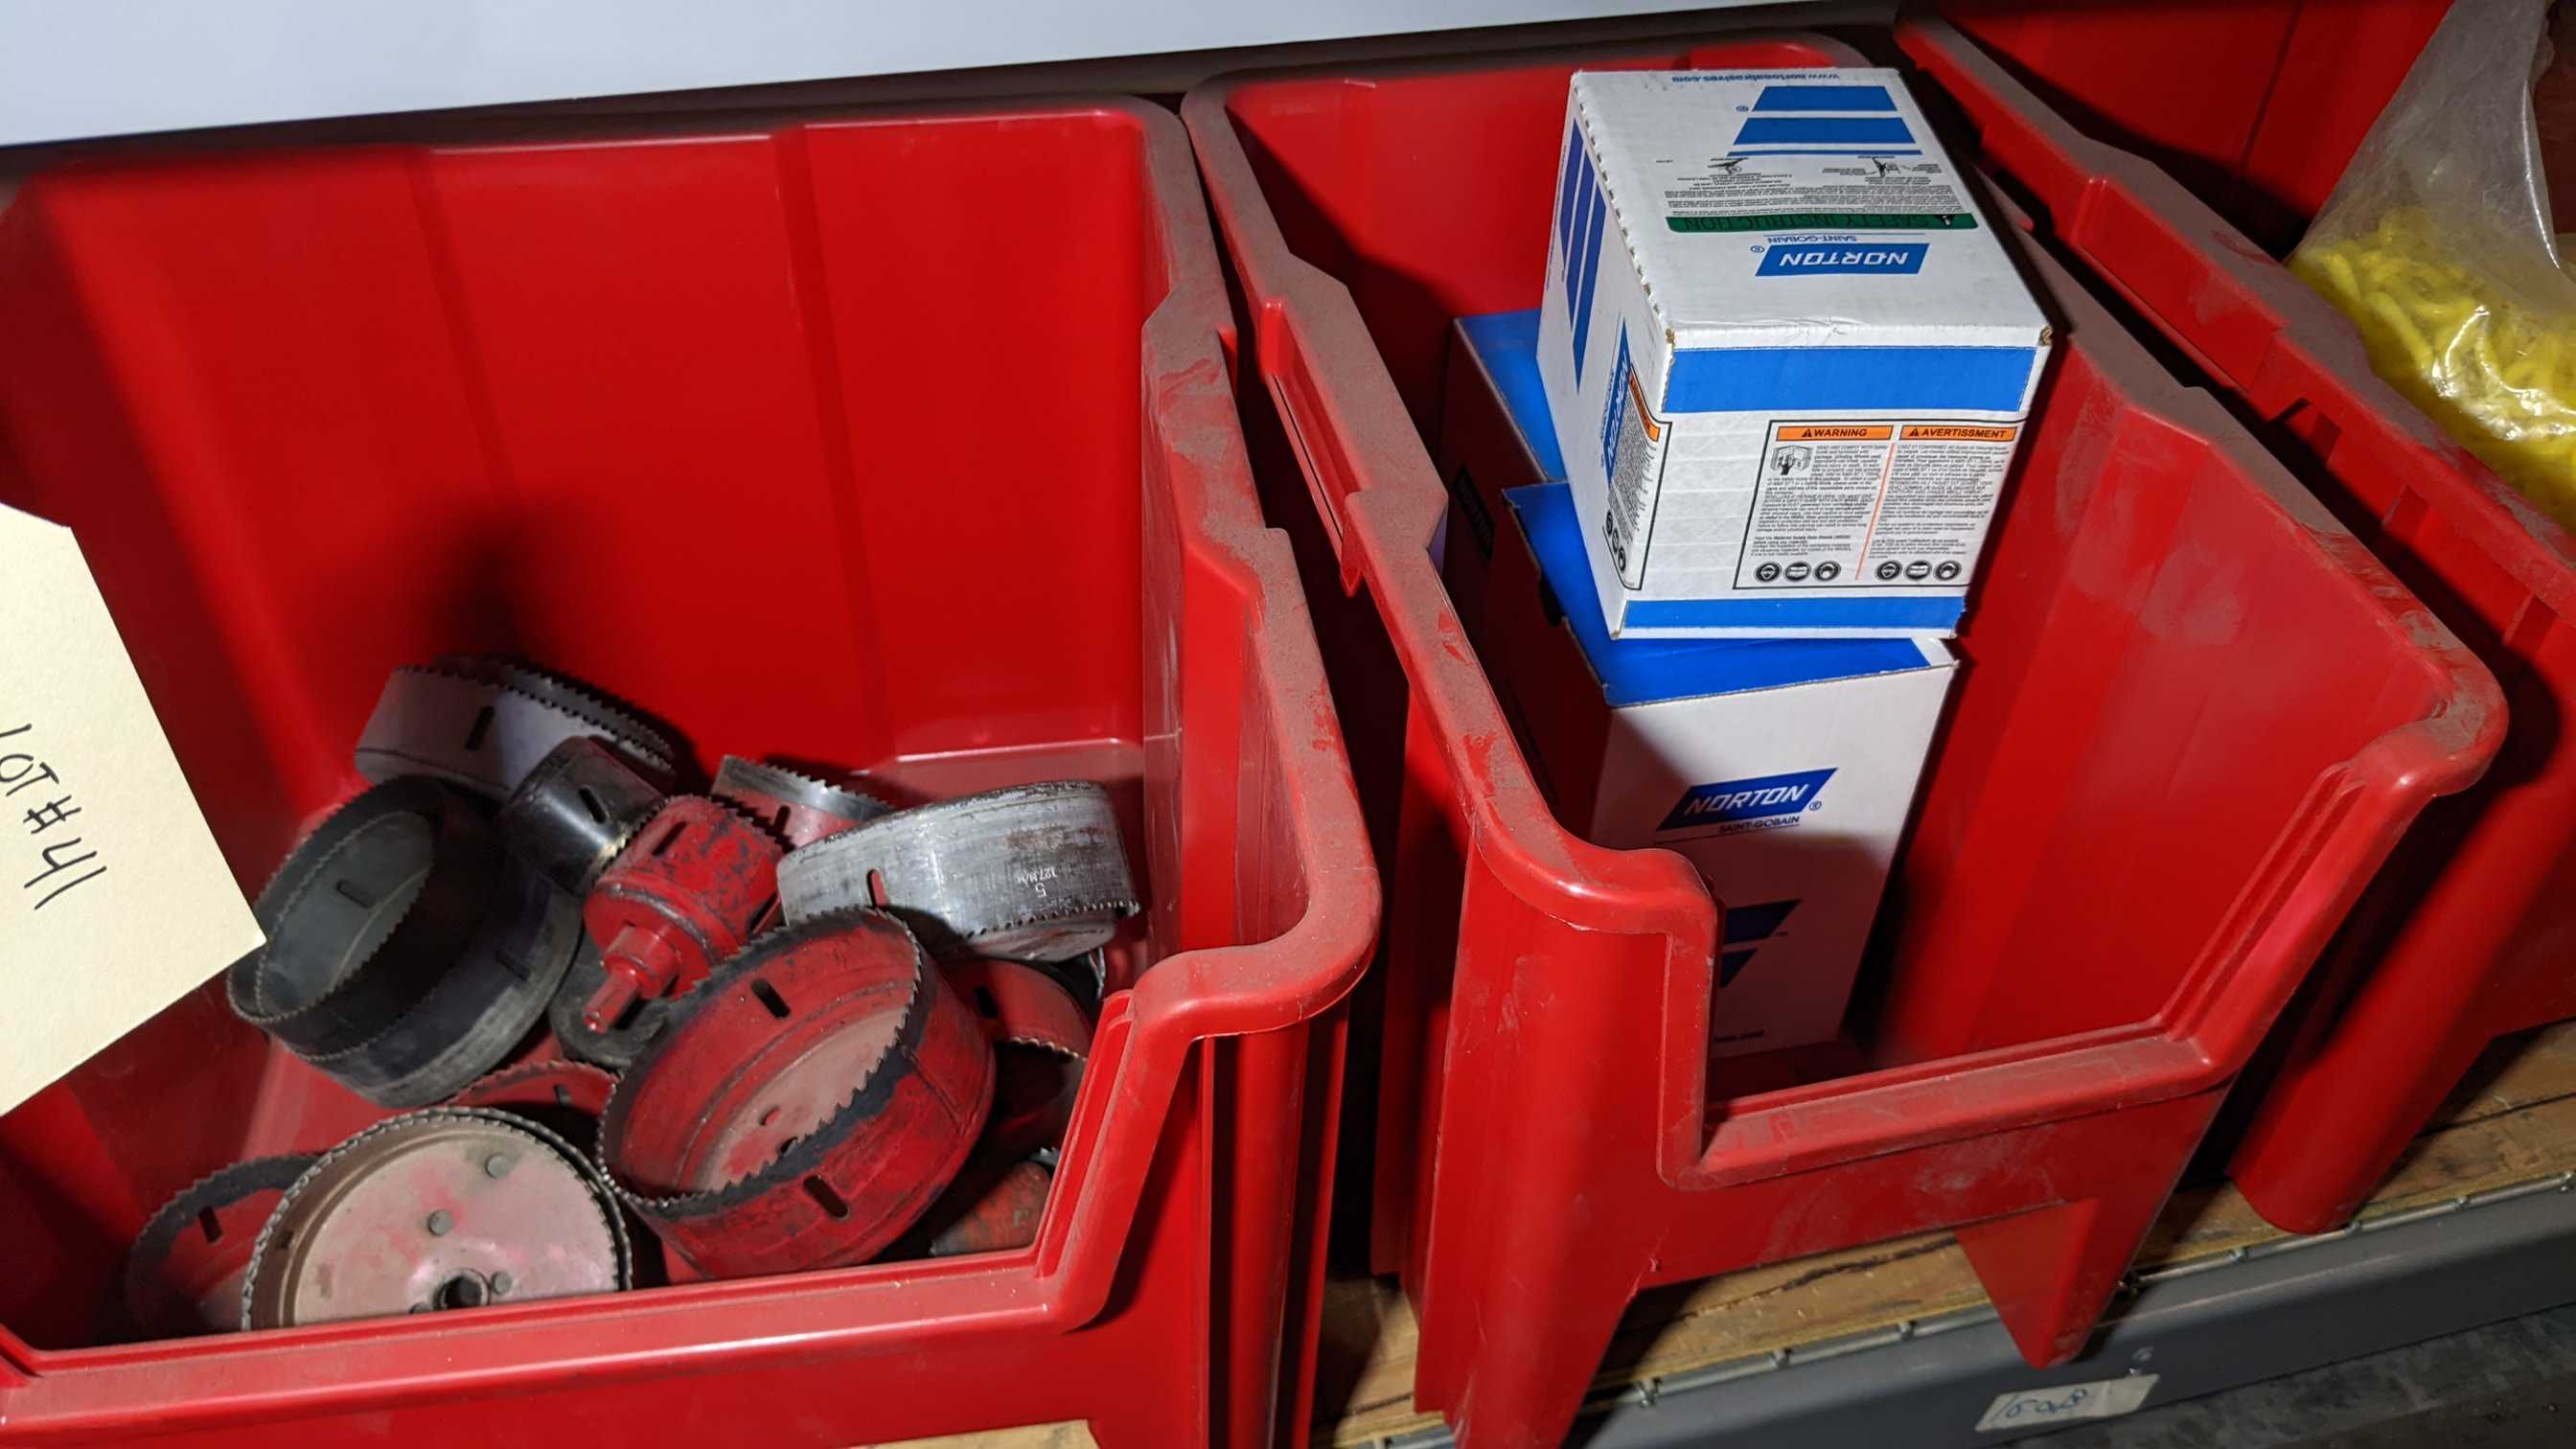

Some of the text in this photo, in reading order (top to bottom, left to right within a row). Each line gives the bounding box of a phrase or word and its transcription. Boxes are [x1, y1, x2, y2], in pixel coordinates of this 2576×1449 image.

[1767, 235, 1857, 243] SAINT-GOBAIN
[1779, 251, 1908, 266] NORTON
[1606, 350, 1629, 460] NORTON
[1814, 428, 1867, 438] WARNING
[1920, 427, 2007, 439] AVERTISSMENT
[1684, 783, 1810, 816] NORTON
[1717, 816, 1801, 834] SAINT-GOBAIN
